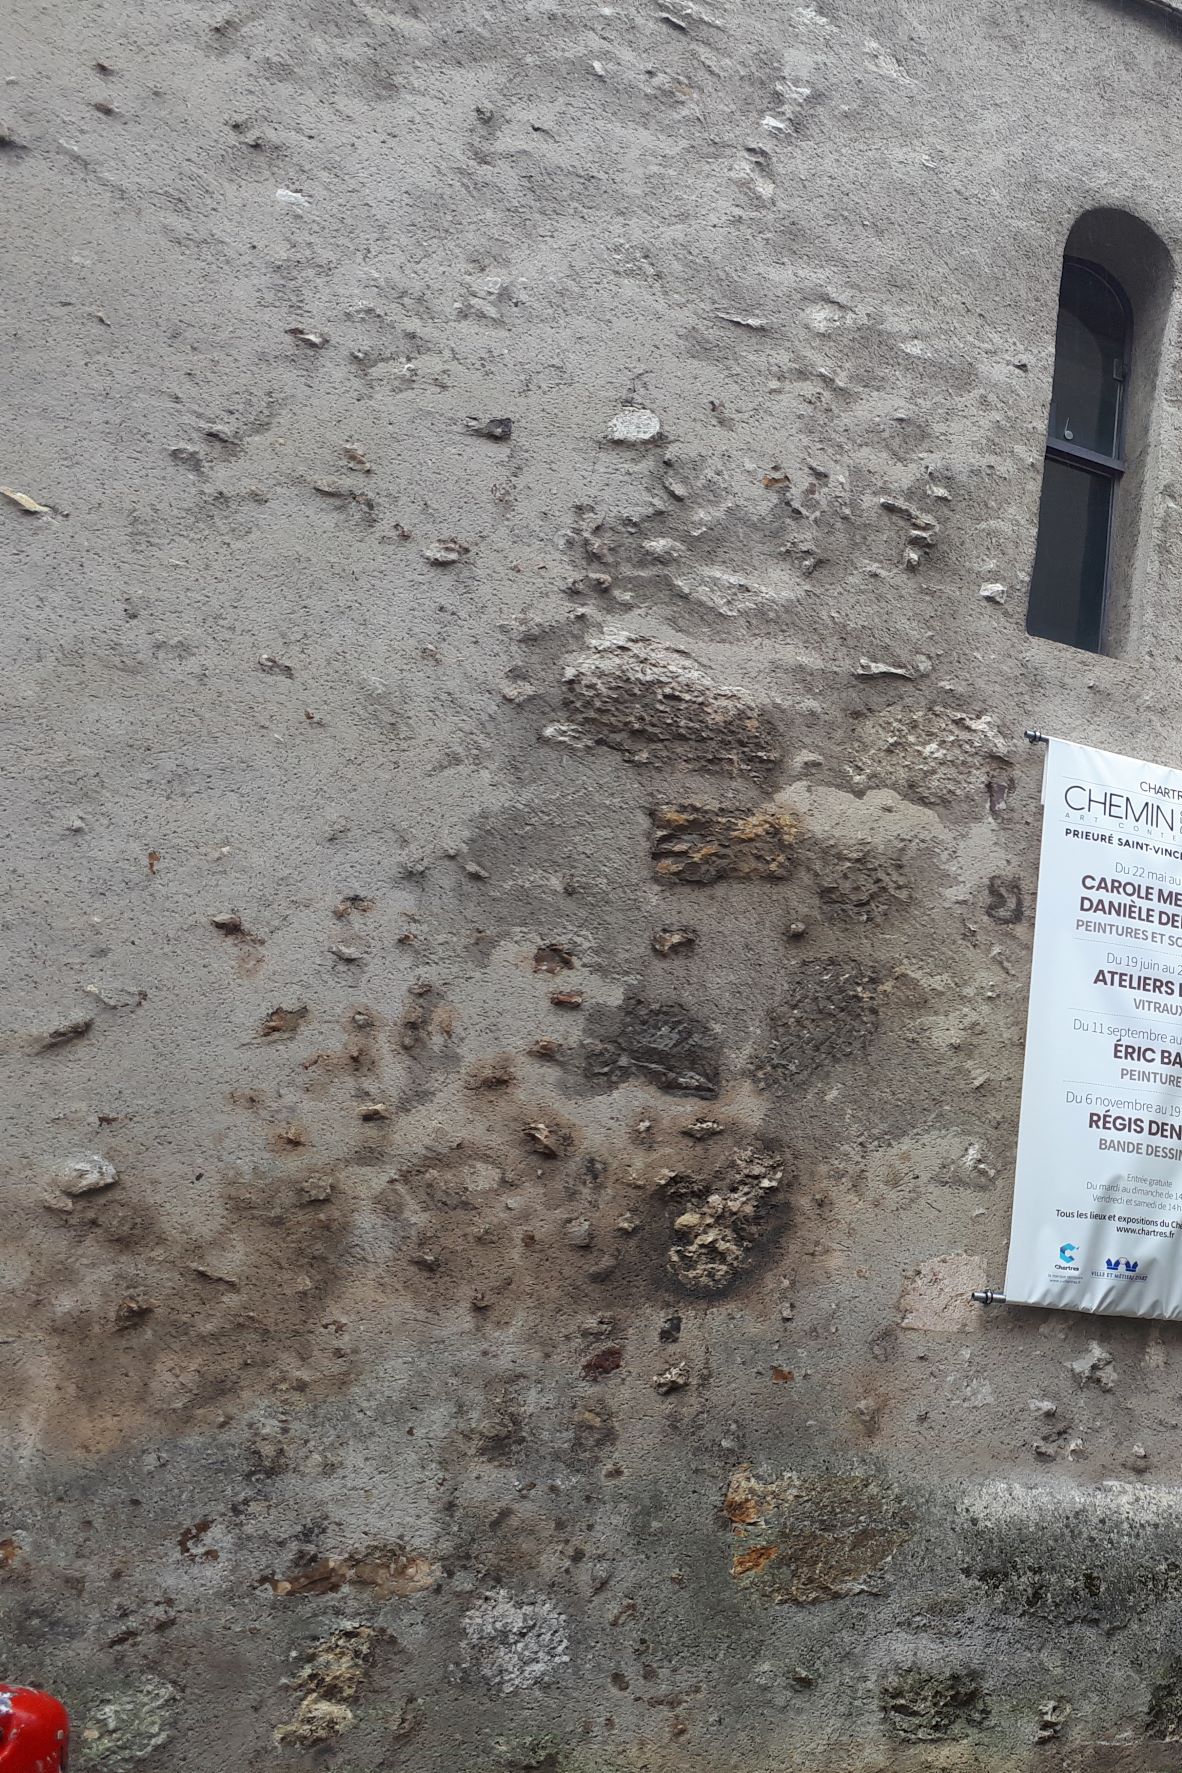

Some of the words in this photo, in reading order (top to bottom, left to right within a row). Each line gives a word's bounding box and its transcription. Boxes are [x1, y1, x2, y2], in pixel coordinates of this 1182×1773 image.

[1064, 785, 1174, 832] CHEMIN
[1065, 812, 1099, 823] ART
[1065, 828, 1114, 845] PRIEURÉ
[1115, 861, 1130, 875] Du
[1132, 865, 1145, 879] 22
[1147, 871, 1167, 882] mai
[1168, 875, 1181, 886] au
[1081, 874, 1155, 902] CAROLE
[1079, 896, 1155, 924] DANIÈLE
[1076, 918, 1149, 941] PEINTURES
[1151, 931, 1166, 945] ET
[1106, 952, 1122, 965] Du
[1126, 955, 1138, 968] 19
[1139, 957, 1160, 972] juin
[1162, 963, 1175, 975] au
[1093, 969, 1175, 996] ATELIERS
[1073, 1018, 1089, 1031] Du
[1092, 1021, 1104, 1035] 11
[1107, 1025, 1168, 1043] septembre
[1169, 1034, 1182, 1046] au
[1113, 1038, 1157, 1064] ÉRIC
[1066, 1090, 1083, 1104] Du
[1085, 1093, 1093, 1105] 6
[1095, 1096, 1153, 1113] novembre
[1154, 1103, 1167, 1115] au
[1169, 1105, 1181, 1117] 19
[1088, 1109, 1145, 1134] RÉGIS
[1098, 1138, 1144, 1155] BANDE
[1086, 1181, 1097, 1190] Du
[1099, 1183, 1120, 1192] mardi
[1121, 1186, 1131, 1194] au
[1131, 1186, 1164, 1199] dimanche
[1164, 1191, 1173, 1199] de
[1127, 1173, 1148, 1184] Entrée
[1092, 1194, 1125, 1205] Vendredi
[1125, 1198, 1133, 1206] et
[1157, 1201, 1167, 1210] de
[1055, 1209, 1075, 1219] Tous
[1076, 1209, 1088, 1219] les
[1089, 1211, 1107, 1221] lieux
[1107, 1213, 1116, 1222] et
[1117, 1215, 1159, 1227] expositions
[1159, 1219, 1170, 1228] du
[1116, 1226, 1176, 1239] www.chartres.fr
